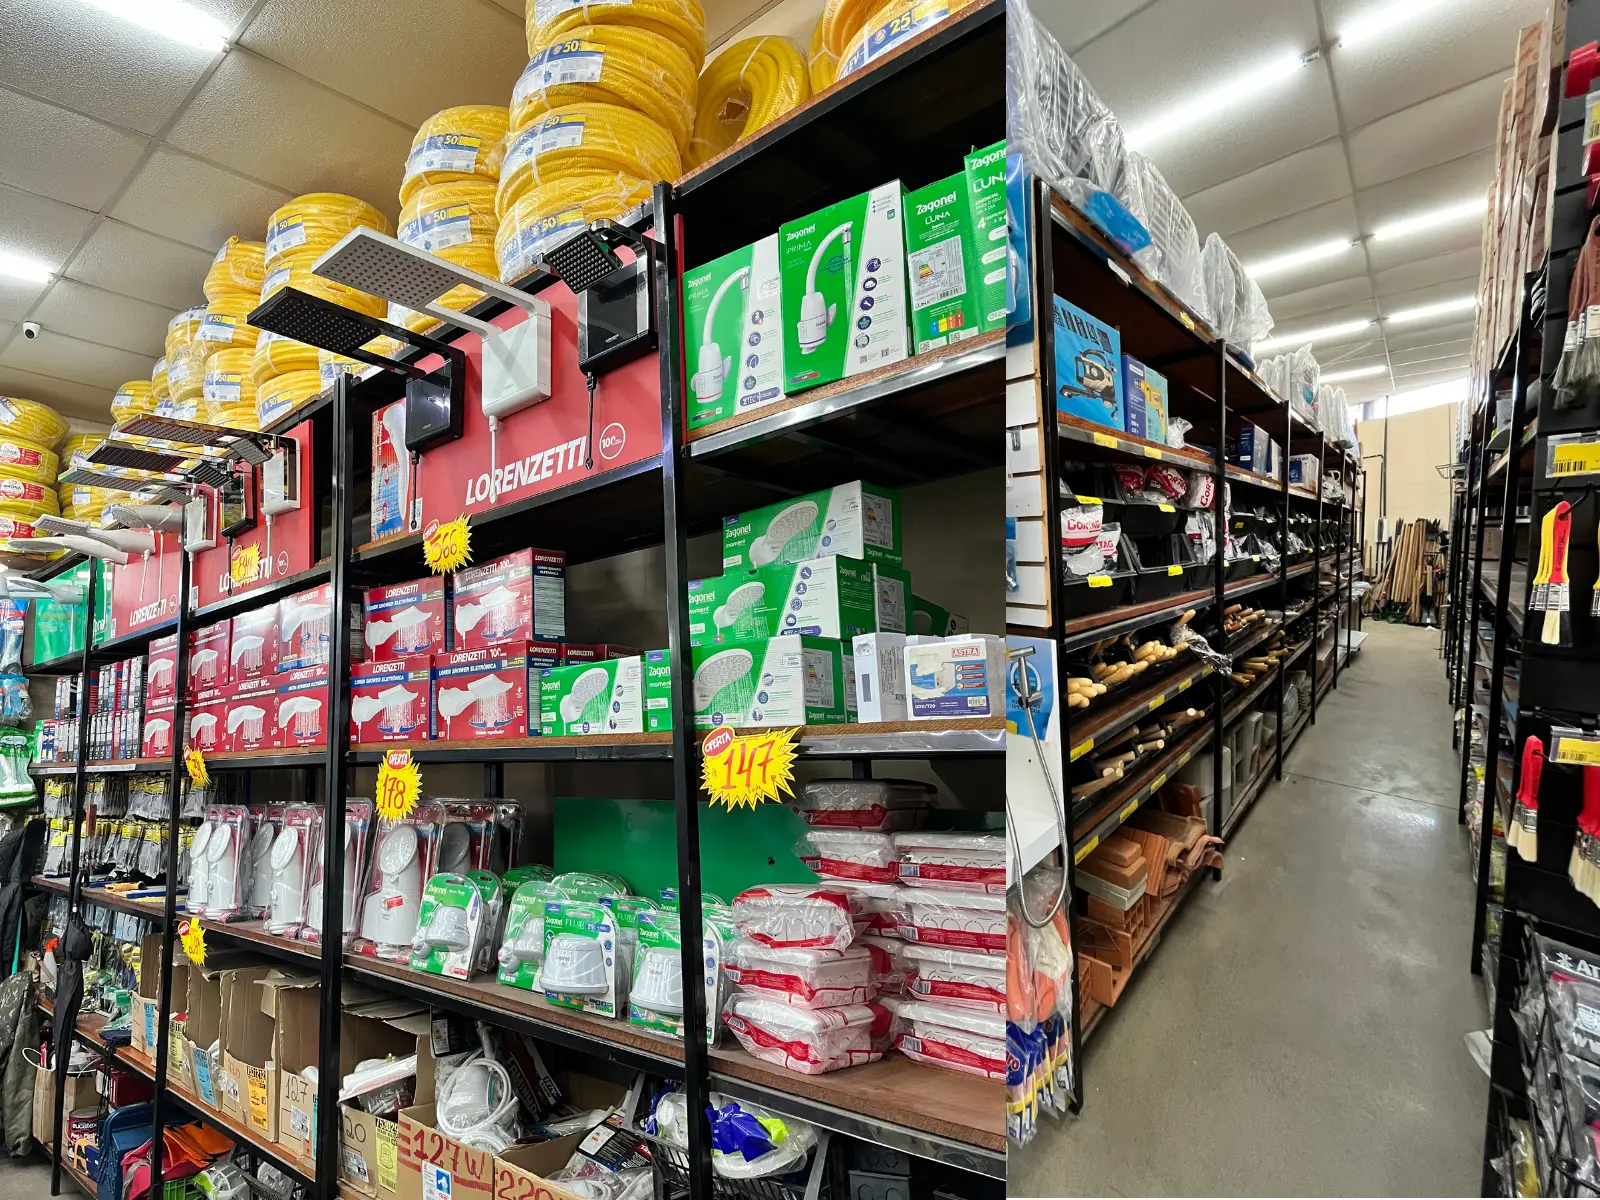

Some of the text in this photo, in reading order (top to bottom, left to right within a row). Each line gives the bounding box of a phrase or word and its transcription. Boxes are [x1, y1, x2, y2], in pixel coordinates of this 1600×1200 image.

[890, 11, 911, 36] 25
[563, 40, 580, 53] 50
[444, 133, 458, 146] 50
[972, 172, 1006, 193] LUN
[915, 191, 957, 215] Zagonel
[434, 209, 447, 222] 50
[925, 211, 951, 225] LUNA
[279, 220, 288, 230] 50
[978, 216, 986, 229] 4
[786, 223, 816, 241] Zagonel
[688, 272, 712, 288] Zagonel
[213, 315, 223, 323] 50
[465, 435, 587, 506] LORENZETTI
[725, 523, 751, 539] Zagonel
[430, 529, 457, 562] 566
[725, 539, 746, 549] moment
[535, 554, 564, 564] LORENZETTI
[218, 555, 273, 594] LOTTI
[465, 562, 497, 581] LORENZETTI
[839, 565, 857, 577] Zagonel
[385, 584, 419, 598] LORENZETTI
[129, 598, 167, 627] LORENZETTI
[449, 649, 487, 664] LORENZETTI
[489, 647, 501, 658] 100
[529, 646, 557, 654] LORENZETTI
[567, 649, 594, 657] LORENZETTI
[953, 647, 979, 657] ASTRA
[372, 661, 405, 674] LORENZETTI
[541, 680, 561, 691] Zagonel
[808, 710, 825, 721] Zagonel
[705, 731, 731, 752] OFERTA
[388, 752, 408, 766] OFERTA
[381, 773, 407, 809] 178
[428, 884, 447, 894] Zagonel
[516, 894, 537, 904] Zagonel
[660, 903, 677, 911] Zagonel
[545, 916, 563, 925] Zagonel
[639, 929, 659, 939] Zagonel
[285, 1074, 309, 1105] 127
